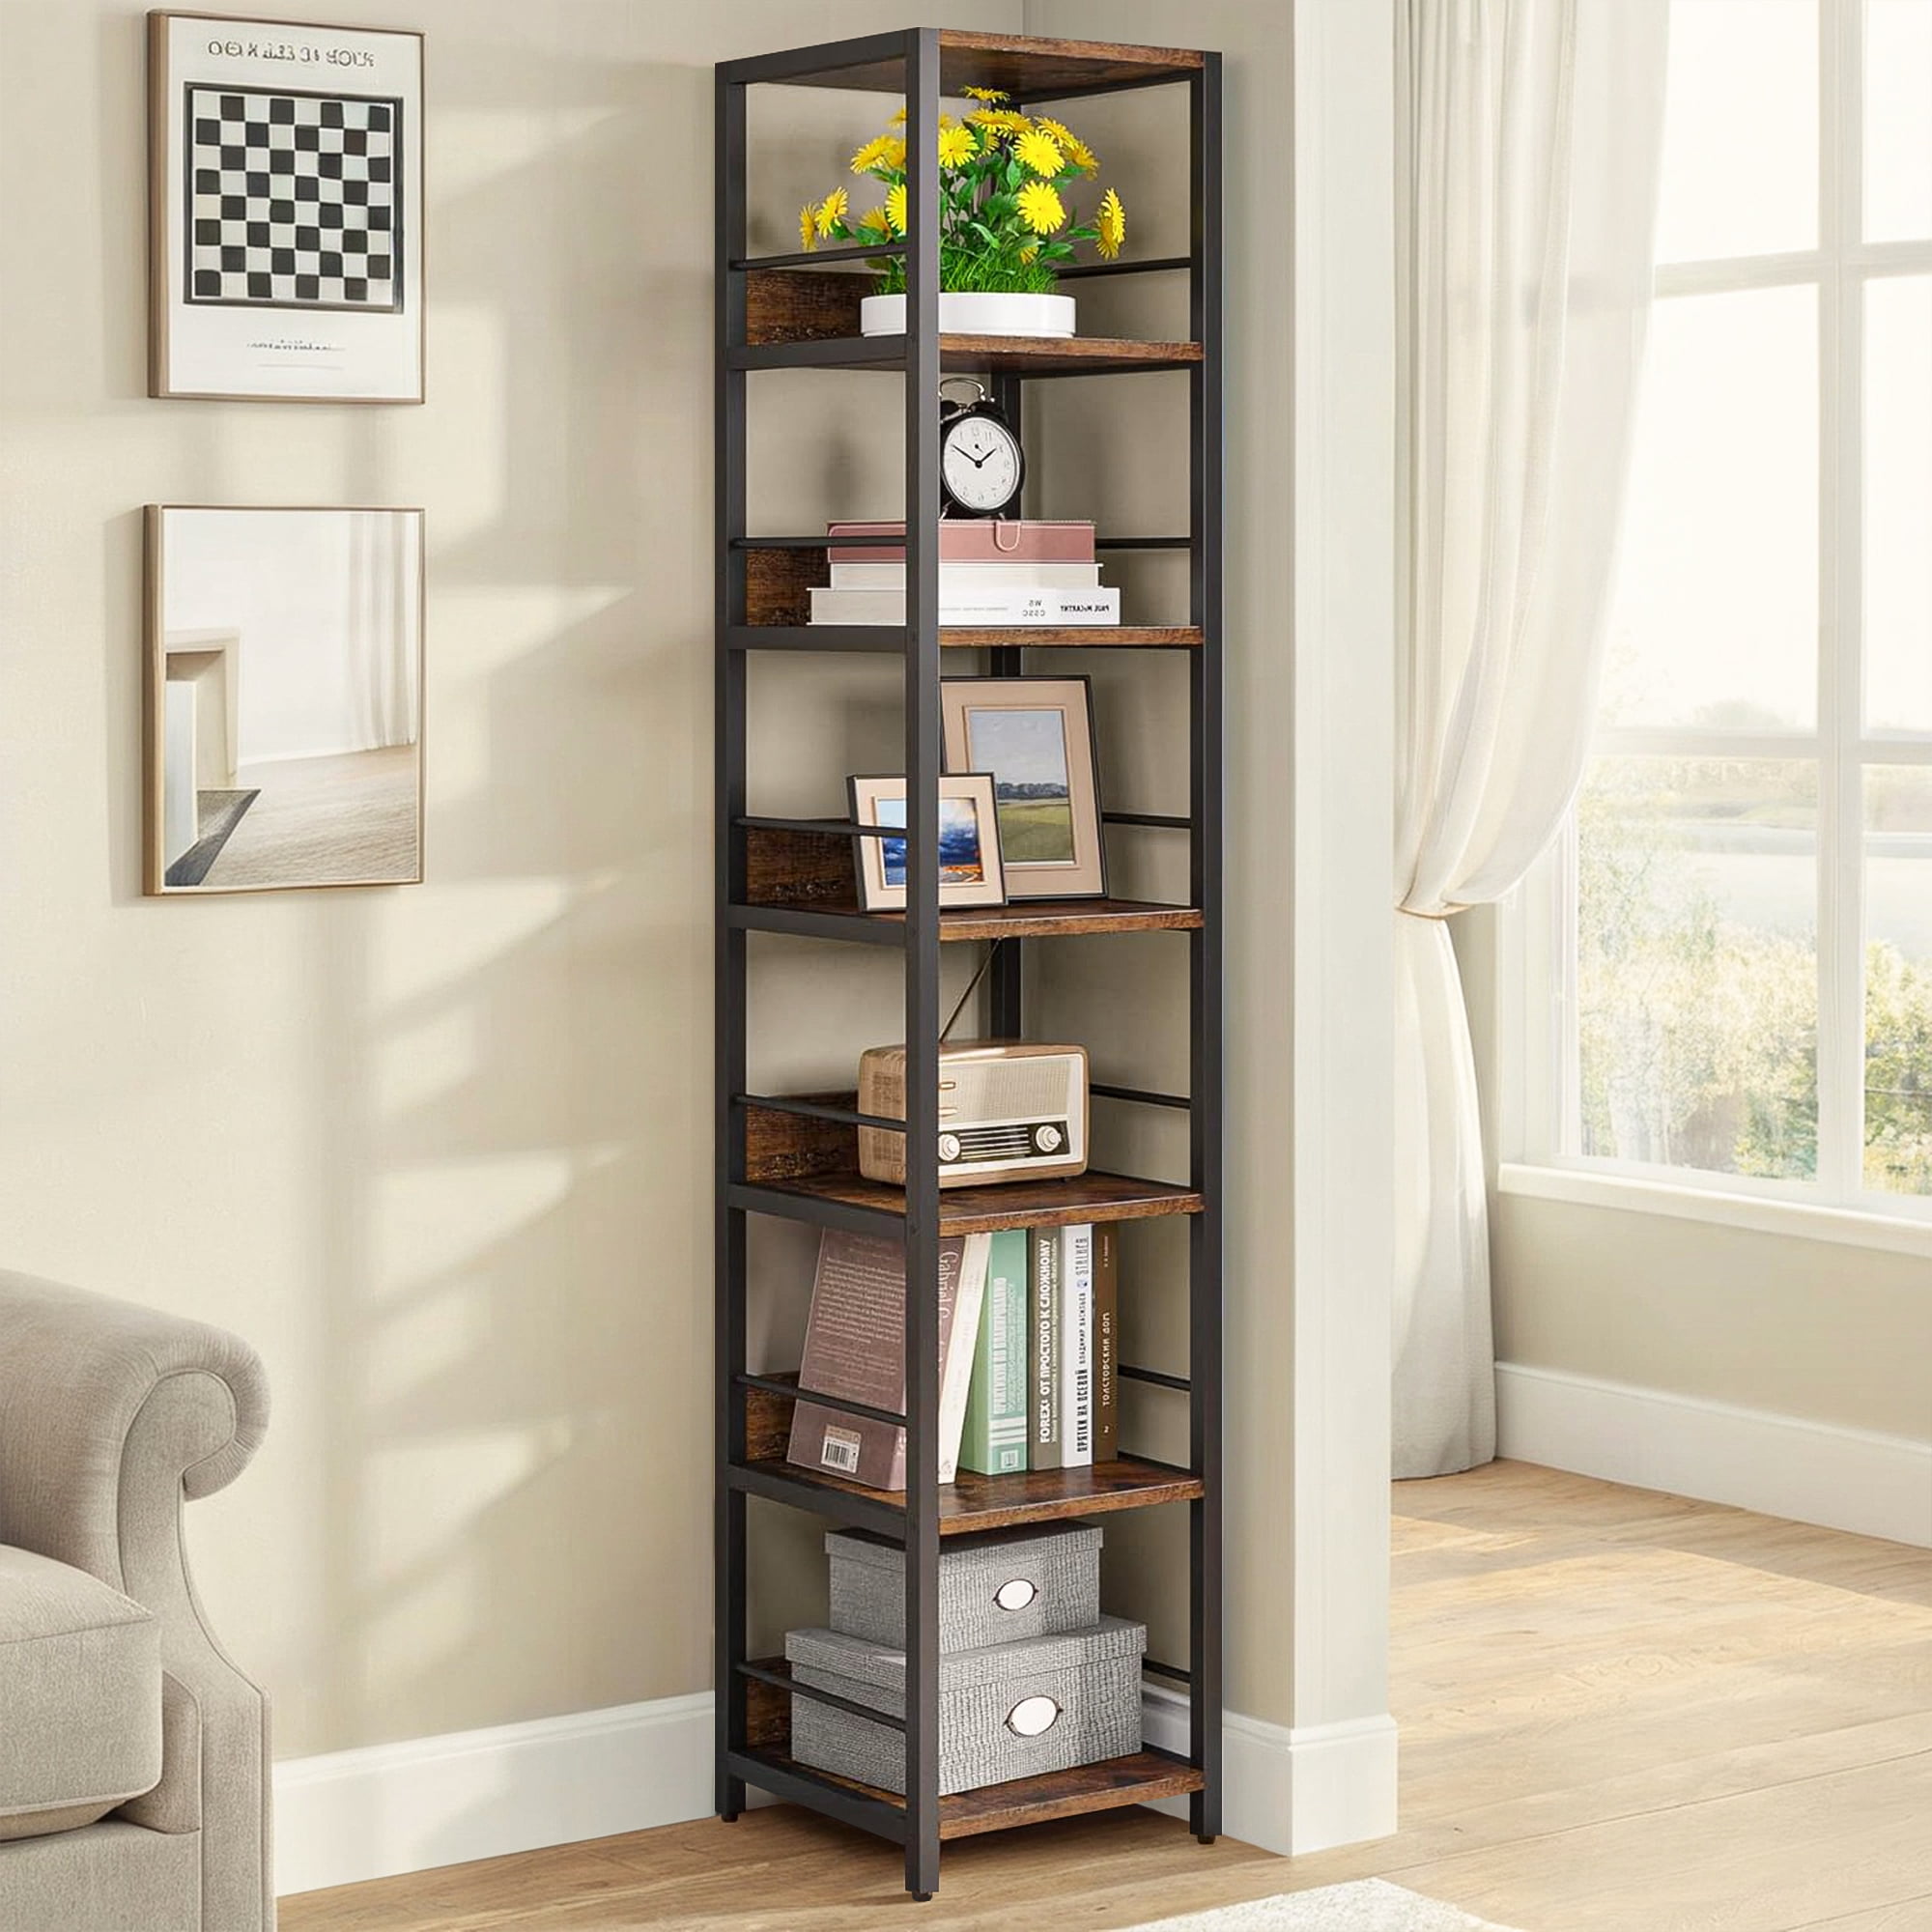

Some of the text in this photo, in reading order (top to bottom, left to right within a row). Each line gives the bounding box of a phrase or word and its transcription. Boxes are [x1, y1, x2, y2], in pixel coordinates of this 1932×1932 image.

[1039, 1239, 1051, 1443] FOREX: ОТ ПРОСТОГО К СЛОЖНОМУ
[1074, 1369, 1088, 1401] ОСЕВОЙ
[1076, 1405, 1088, 1416] НА
